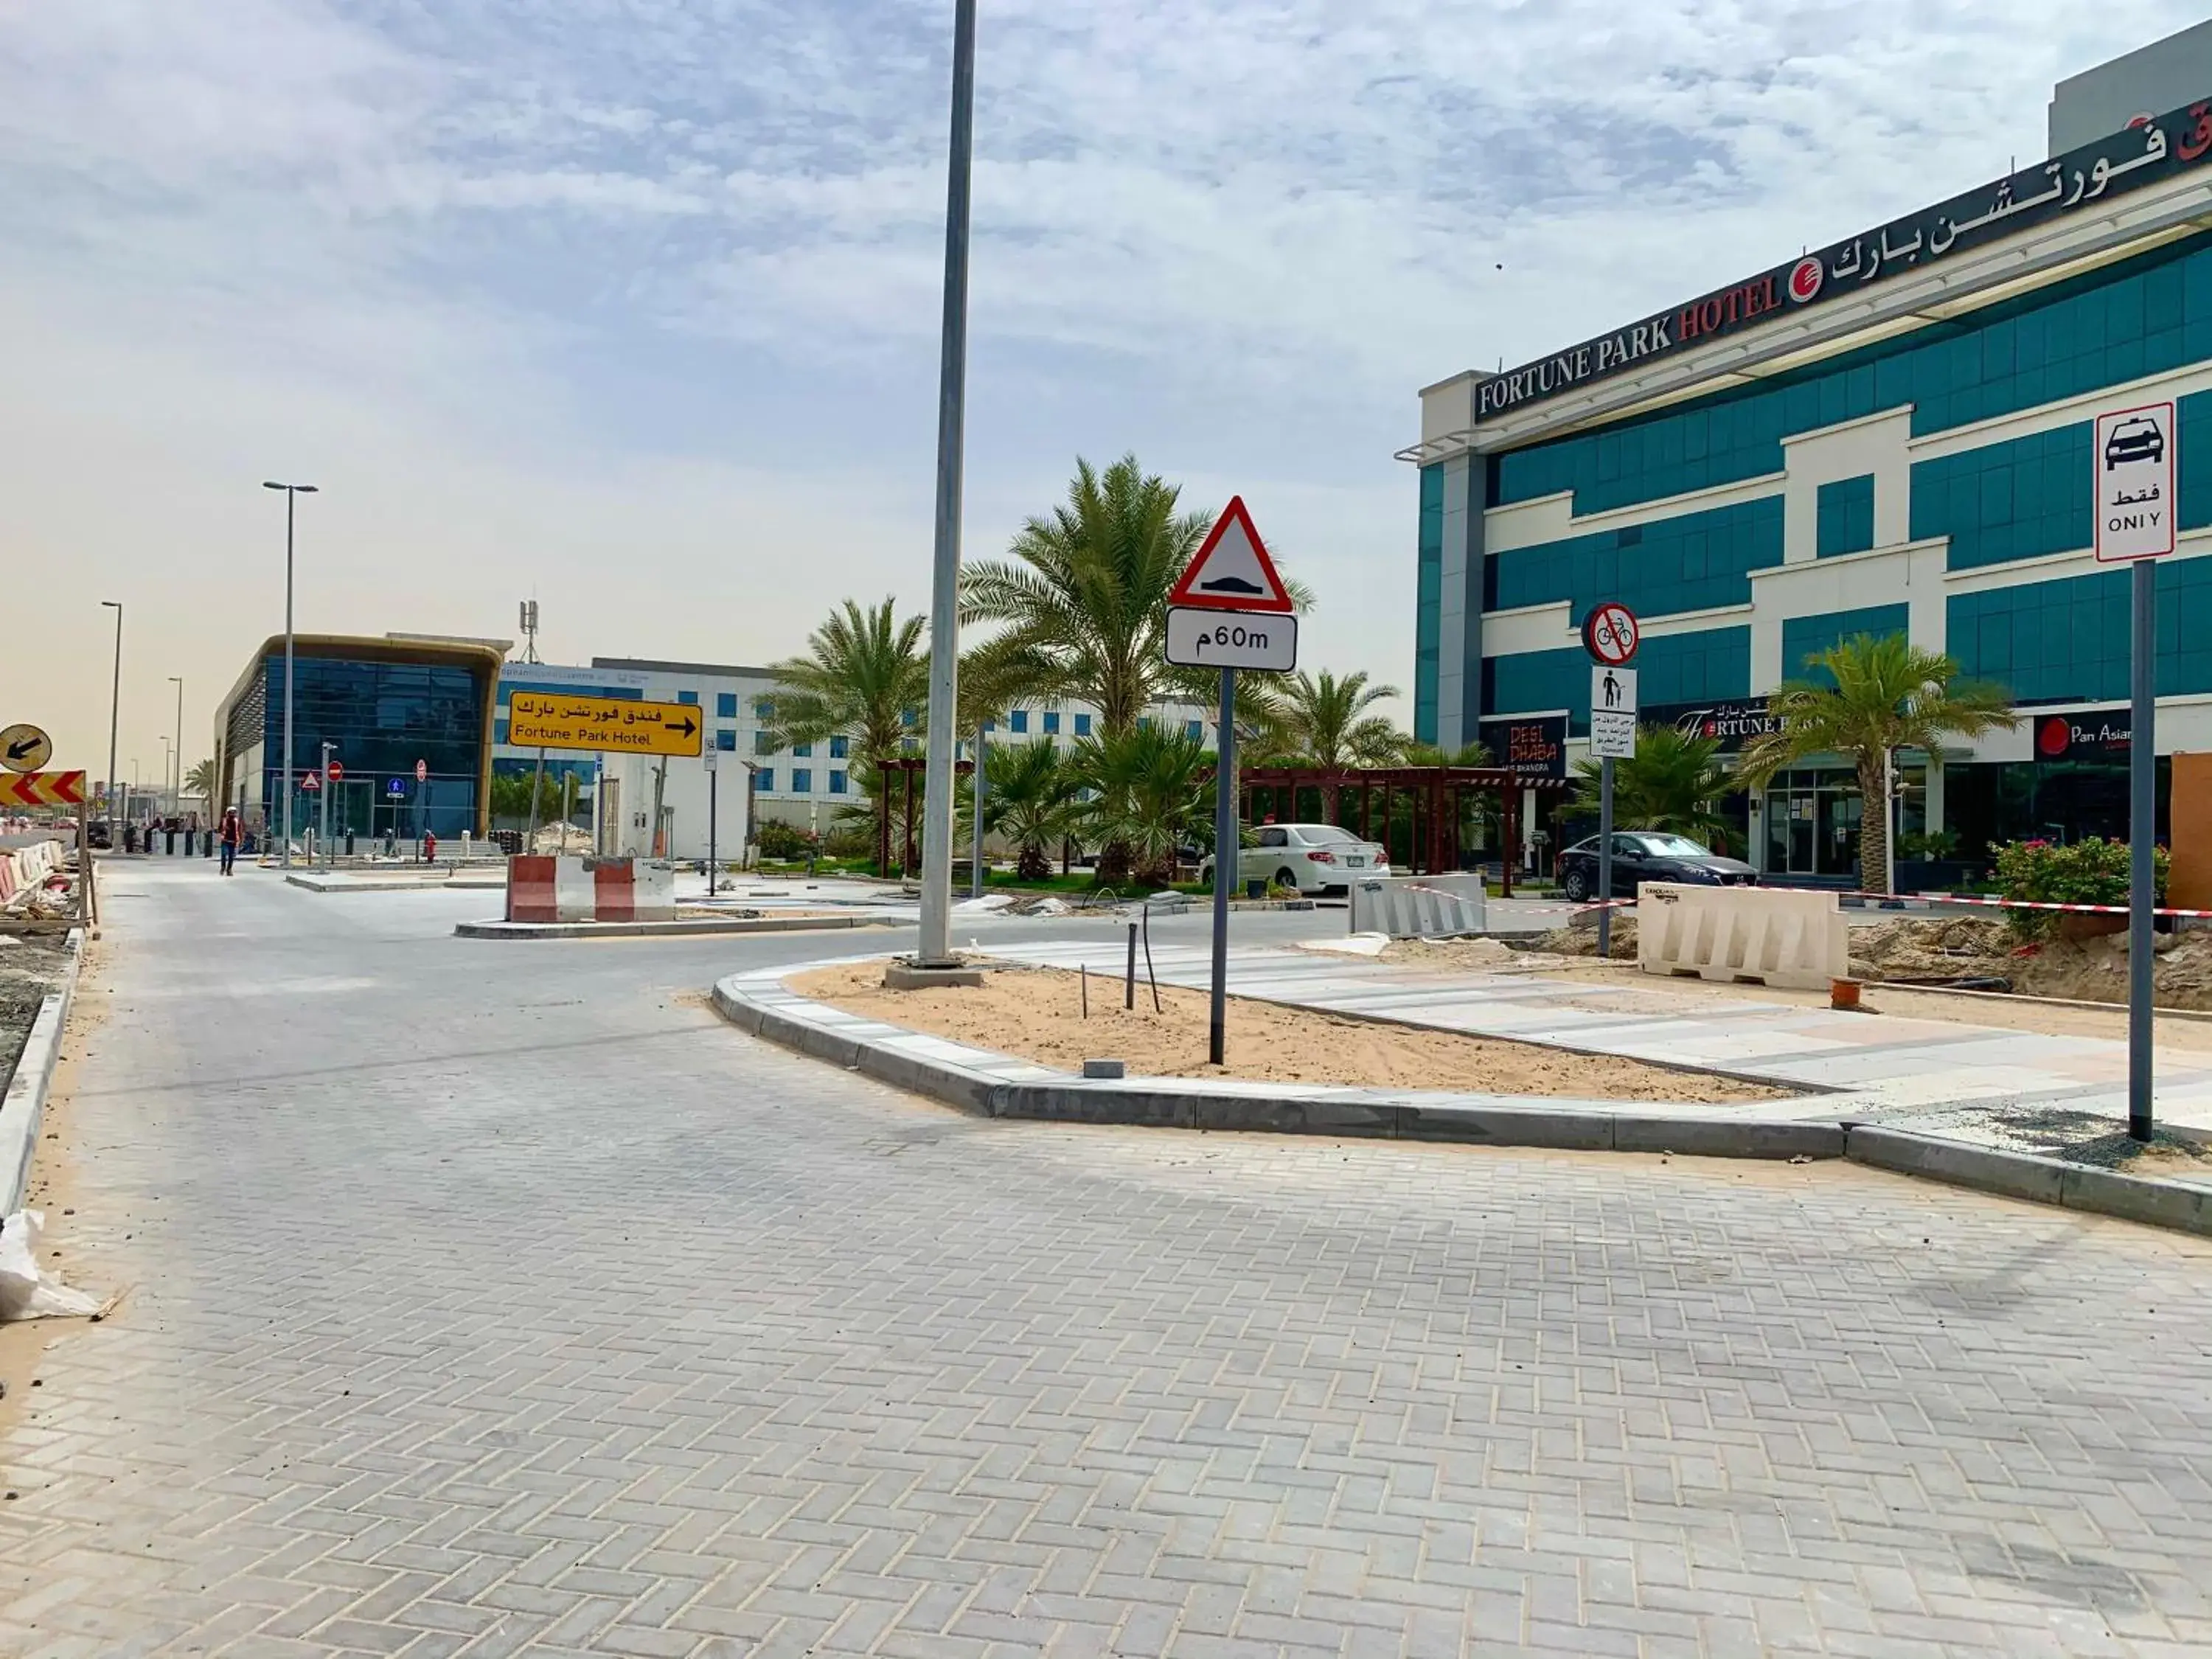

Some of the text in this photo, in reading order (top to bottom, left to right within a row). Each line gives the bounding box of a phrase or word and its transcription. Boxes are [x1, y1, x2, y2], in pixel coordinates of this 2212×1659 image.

[1930, 123, 2167, 254] فورتشن
[1832, 226, 1922, 280] بارك
[1480, 276, 1783, 414] FORTUNE PARK HOTEL
[2111, 483, 2160, 506] فقط
[517, 700, 662, 725] فندق فورتشن بارك
[515, 724, 652, 745] Fortune Park Hotel
[1510, 725, 1544, 744] DESI
[2071, 726, 2095, 743] Pan
[1509, 742, 1557, 763] DHABA
